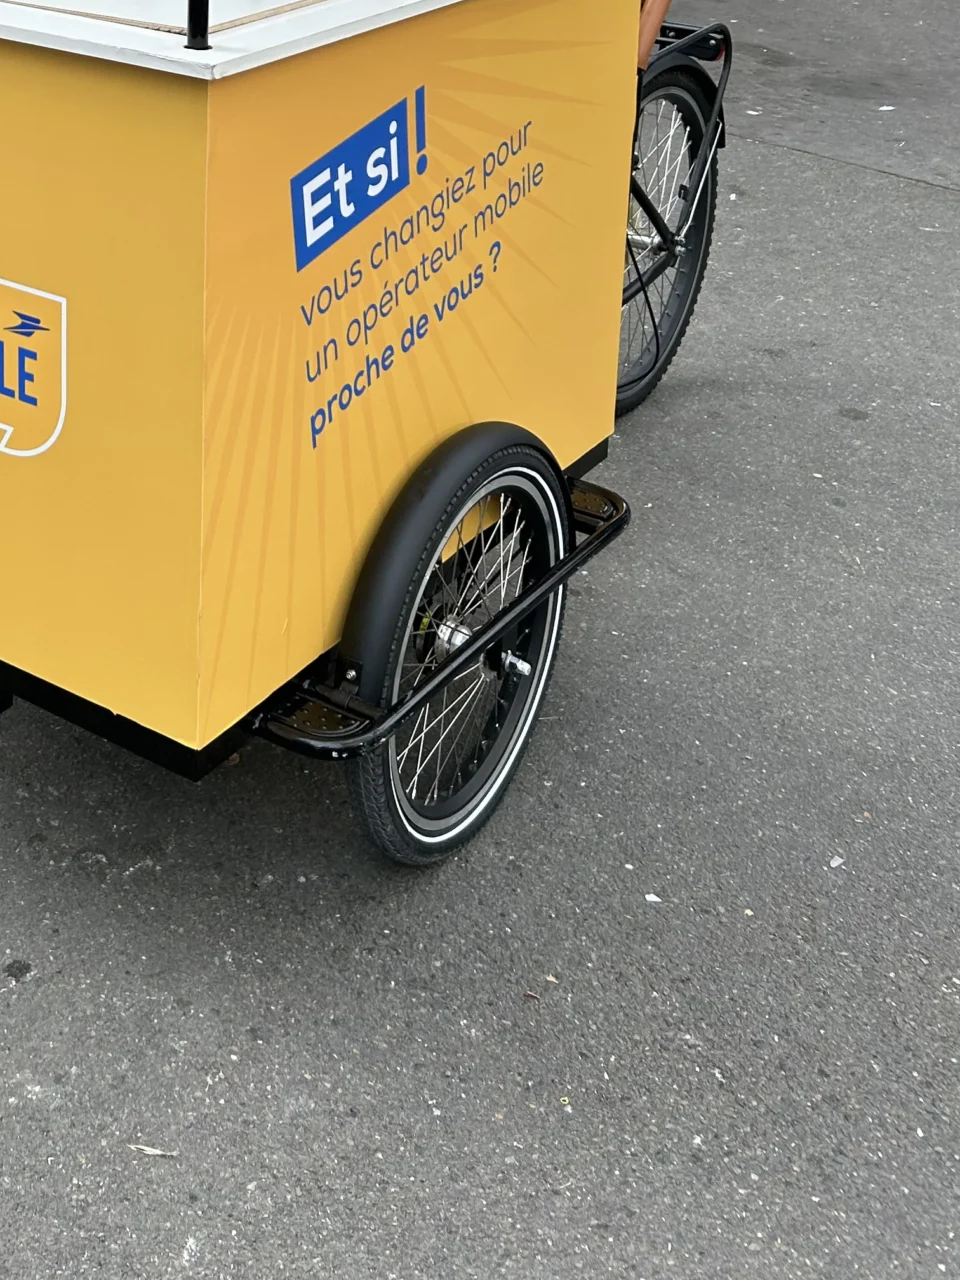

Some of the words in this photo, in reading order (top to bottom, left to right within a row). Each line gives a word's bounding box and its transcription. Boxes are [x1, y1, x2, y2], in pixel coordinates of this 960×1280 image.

[300, 258, 363, 326] vous
[370, 166, 476, 270] changiez
[483, 120, 533, 190] pour
[302, 163, 355, 248] Et
[367, 120, 398, 197] si
[305, 337, 338, 383] un
[346, 224, 468, 345] opérateur
[474, 161, 545, 238] mobile
[310, 344, 395, 450] proche
[401, 313, 430, 353] de
[433, 263, 484, 322] vous
